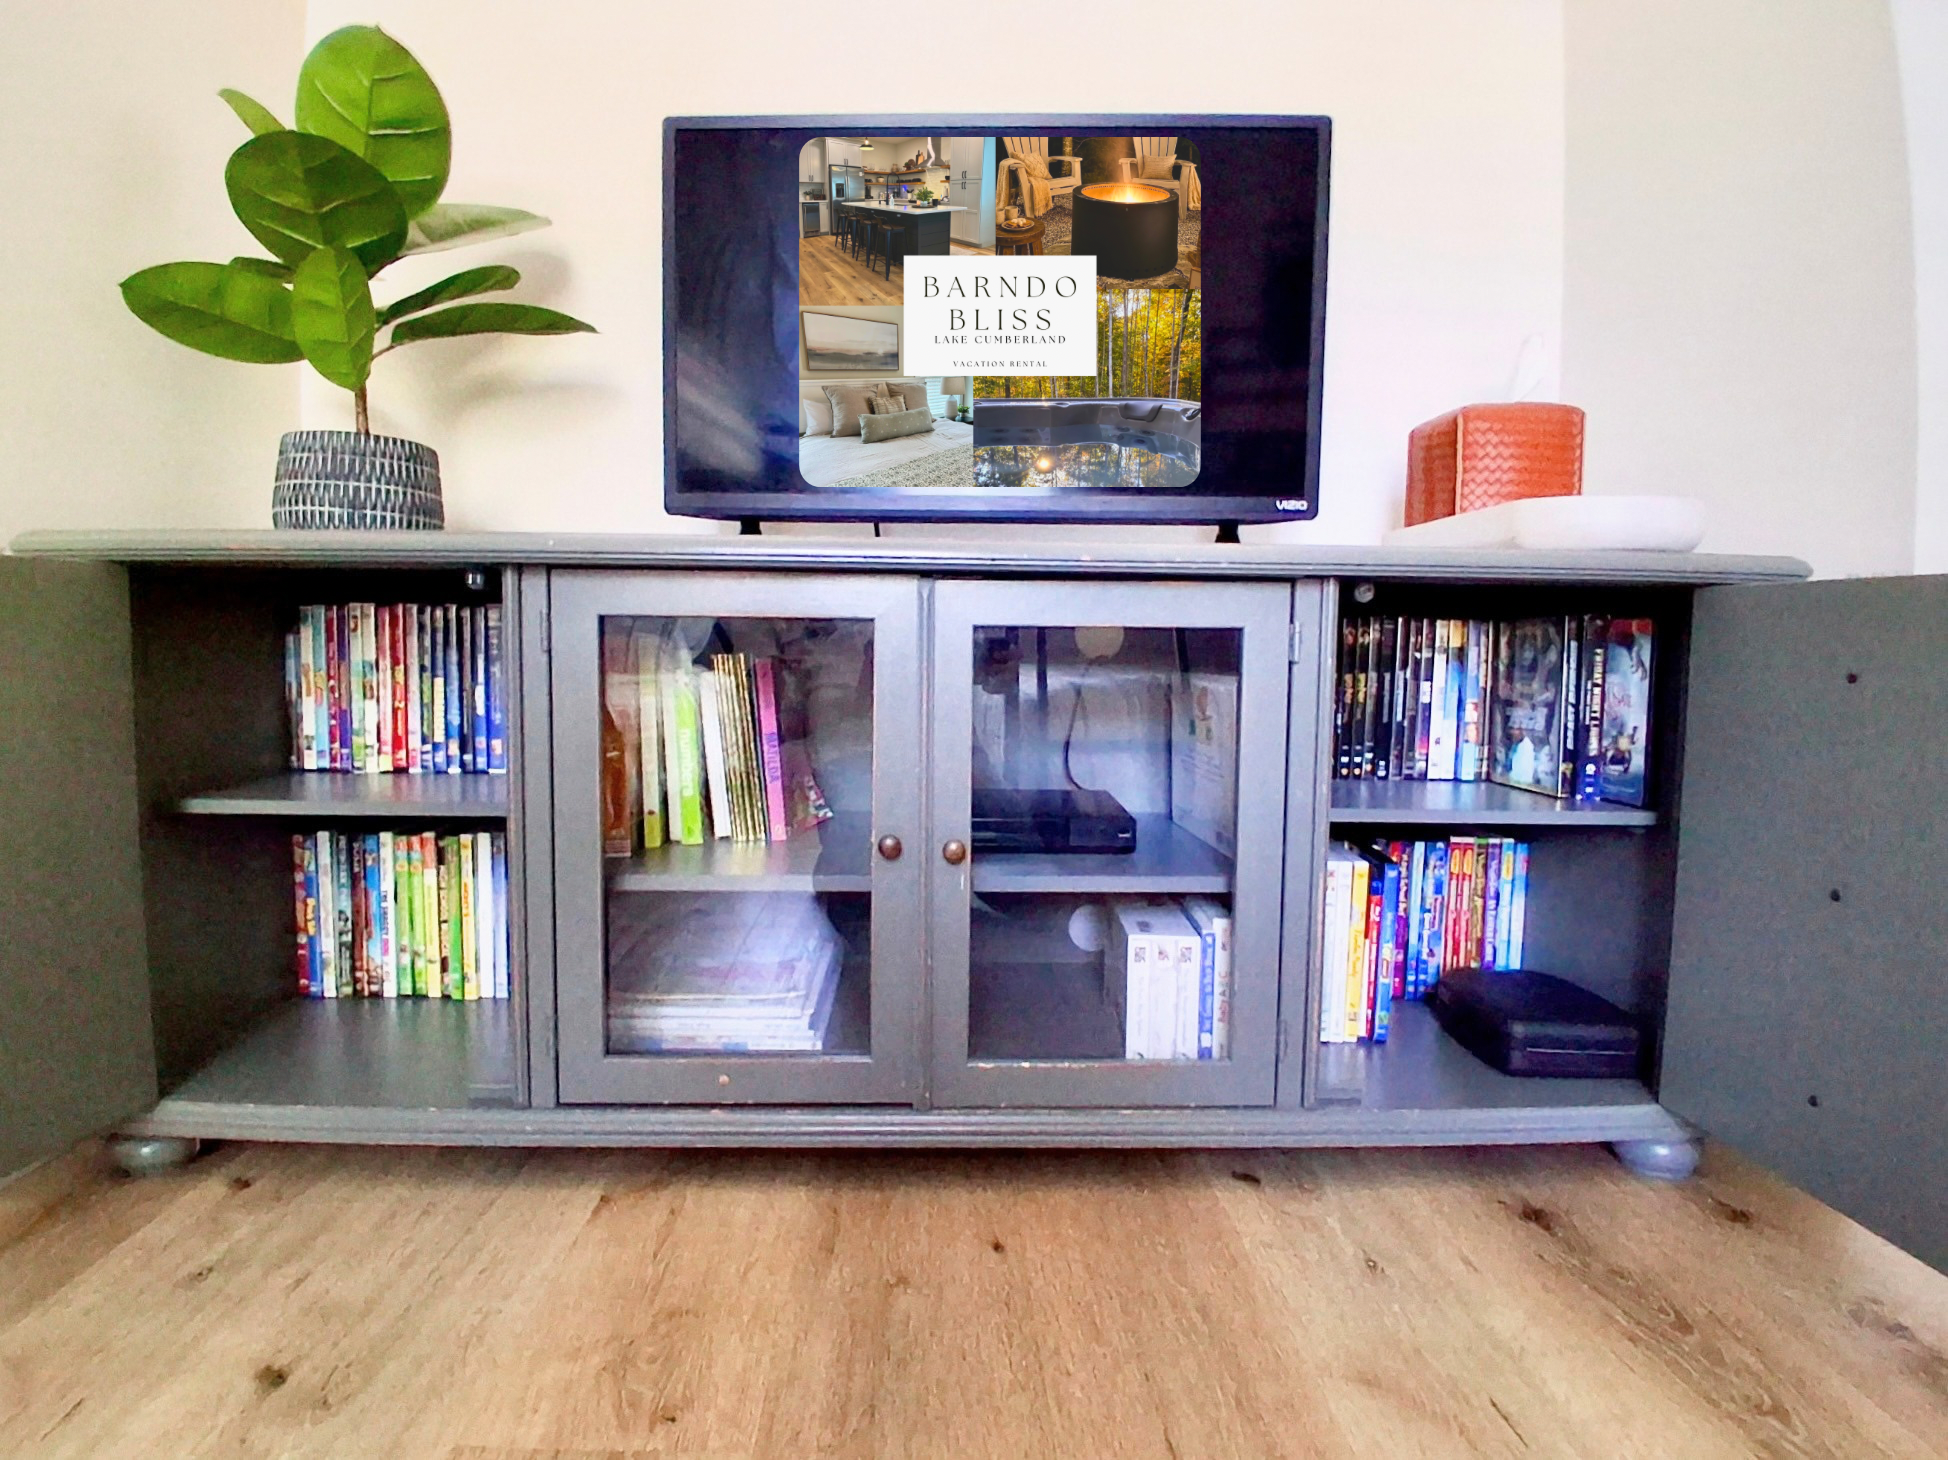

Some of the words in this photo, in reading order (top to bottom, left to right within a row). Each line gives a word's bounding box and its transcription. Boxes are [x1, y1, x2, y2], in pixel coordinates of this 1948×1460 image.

[924, 275, 1077, 298] BARNDO
[950, 308, 1051, 331] BLISS
[934, 335, 968, 344] LAKE
[974, 335, 1066, 344] CUMBERLAND
[953, 360, 1005, 368] VACATION
[1009, 360, 1048, 368] RENTAL
[1275, 499, 1309, 511] VIZIO
[1592, 648, 1604, 685] FRIDAY
[678, 728, 694, 797] numbers
[764, 732, 780, 785] MATILDA
